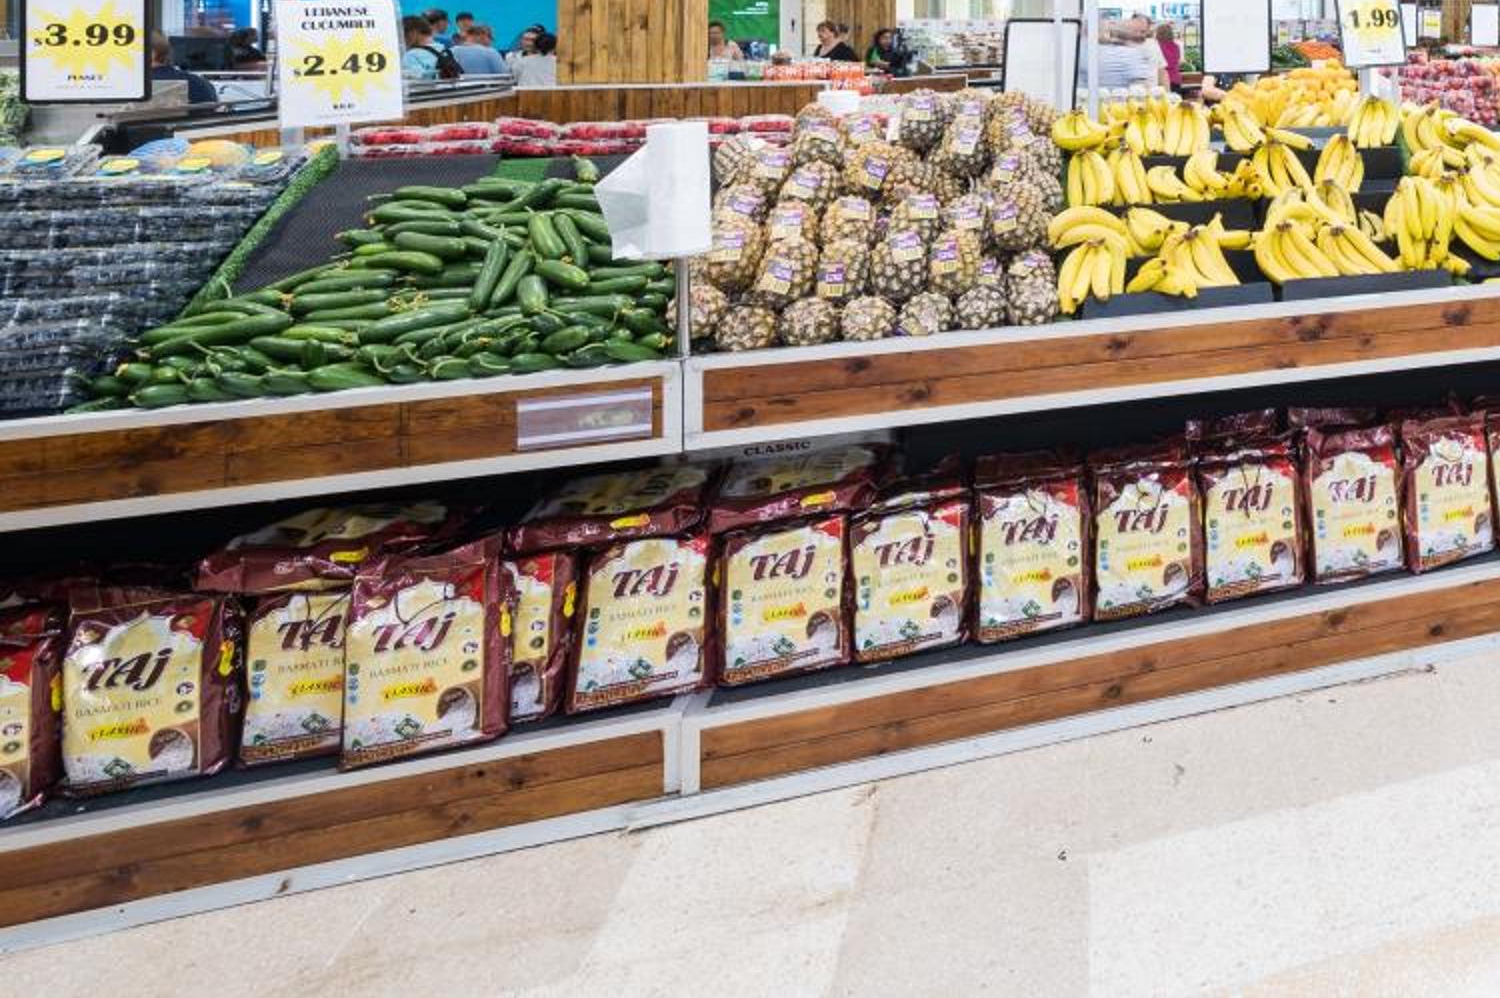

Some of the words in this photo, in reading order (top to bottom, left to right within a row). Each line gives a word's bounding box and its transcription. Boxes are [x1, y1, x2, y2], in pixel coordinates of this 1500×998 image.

[304, 7, 371, 17] LEBANESE
[301, 19, 375, 31] CUCUMBER
[34, 23, 135, 47] $3.99
[743, 440, 812, 456] CLASSIC
